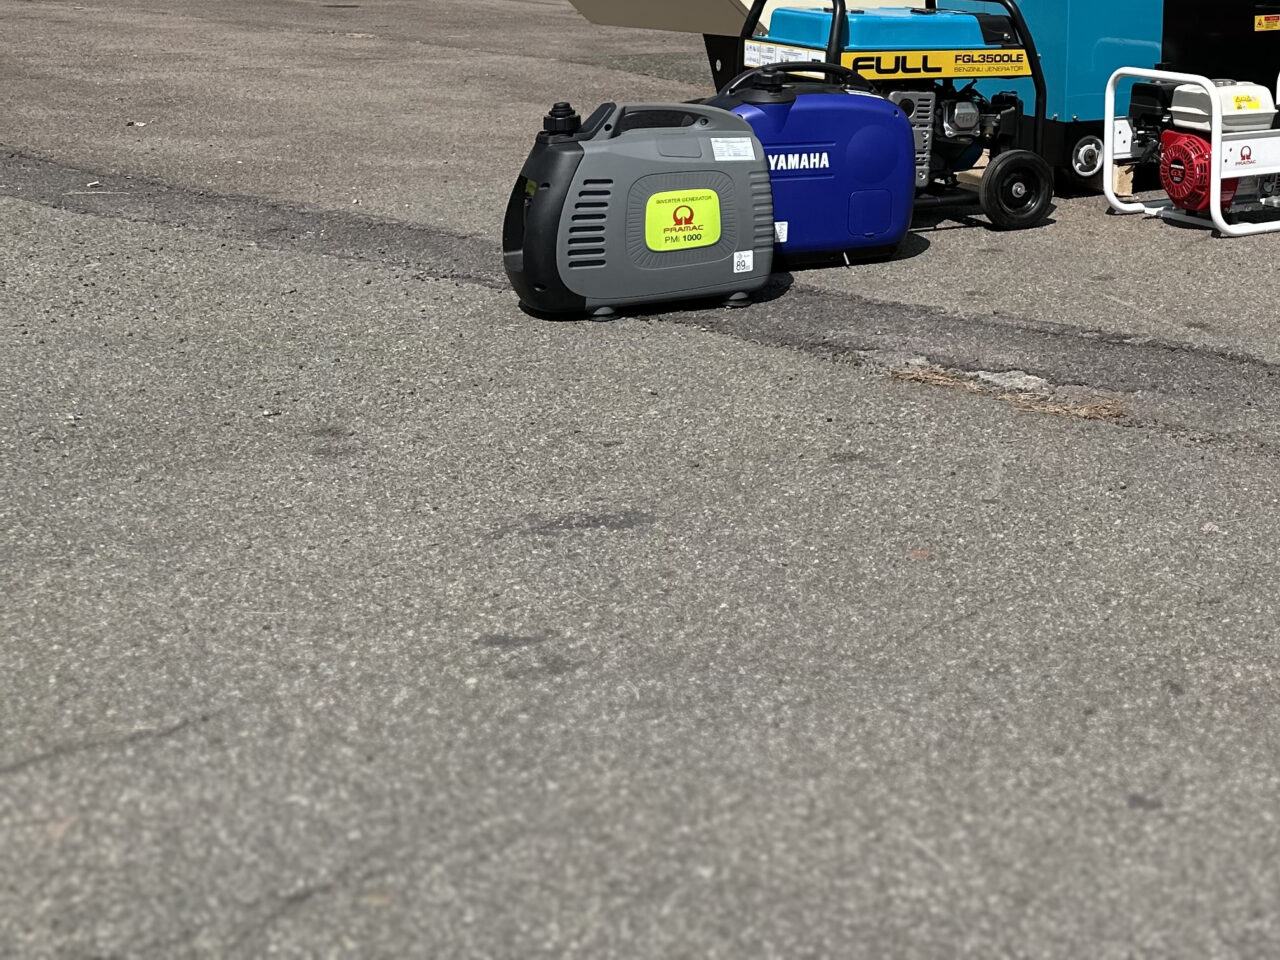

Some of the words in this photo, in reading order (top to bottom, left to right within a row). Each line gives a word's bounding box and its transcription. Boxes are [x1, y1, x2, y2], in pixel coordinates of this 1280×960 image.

[955, 53, 1024, 64] FGL3500LE
[852, 55, 943, 74] FULL
[768, 152, 830, 170] YAMAHA
[682, 195, 713, 203] GENERATOR
[663, 224, 704, 234] PRAMAC
[683, 233, 702, 241] 1000
[736, 260, 746, 271] 89
